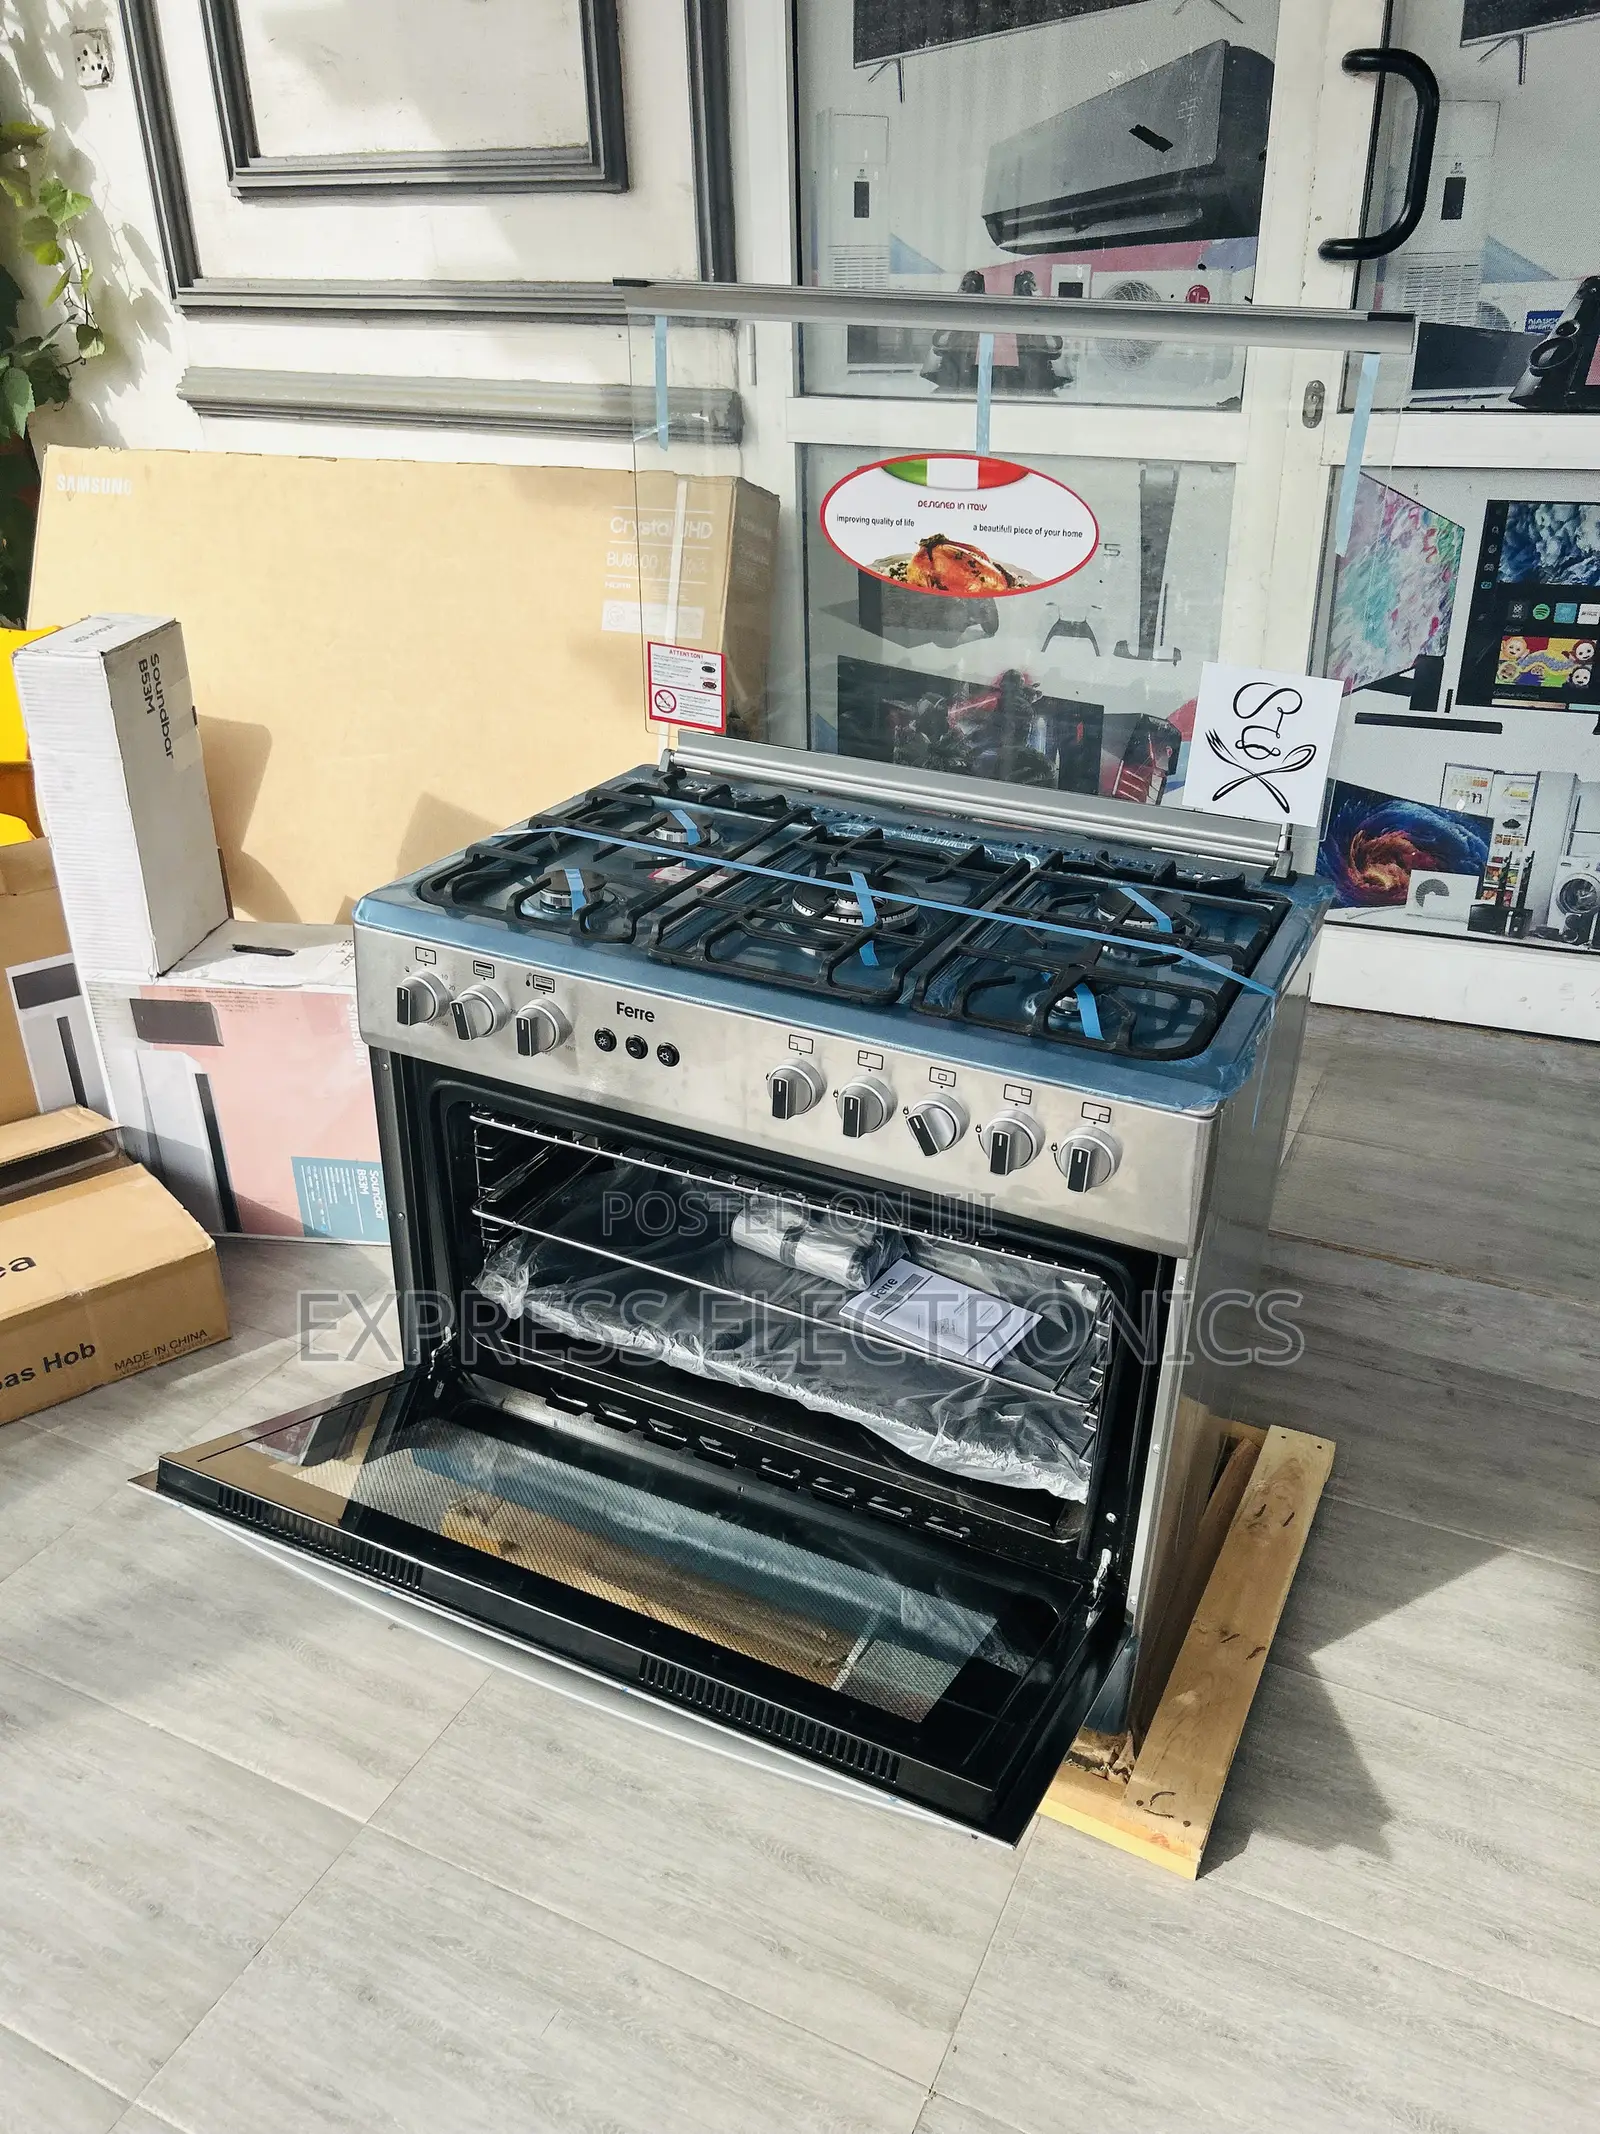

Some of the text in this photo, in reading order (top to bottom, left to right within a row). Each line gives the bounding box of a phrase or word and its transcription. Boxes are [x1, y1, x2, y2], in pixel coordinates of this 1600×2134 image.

[56, 473, 132, 496] SAMSUNG
[917, 500, 988, 512] DESIGNED IN ITALY
[610, 517, 673, 540] Crystal
[836, 514, 915, 528] improving quality of life
[1013, 526, 1033, 537] piece
[1034, 527, 1042, 537] of
[1043, 529, 1061, 539] your
[1062, 528, 1083, 539] home
[138, 658, 156, 714] B53M
[150, 653, 174, 759] Soundbar
[616, 1000, 655, 1023] Ferre
[356, 1168, 369, 1195] B53M
[369, 1169, 385, 1221] Soundbar
[870, 1277, 898, 1300] Ferre
[113, 1328, 208, 1372] MADE IN CHINA
[0, 1342, 96, 1390] as Hob
